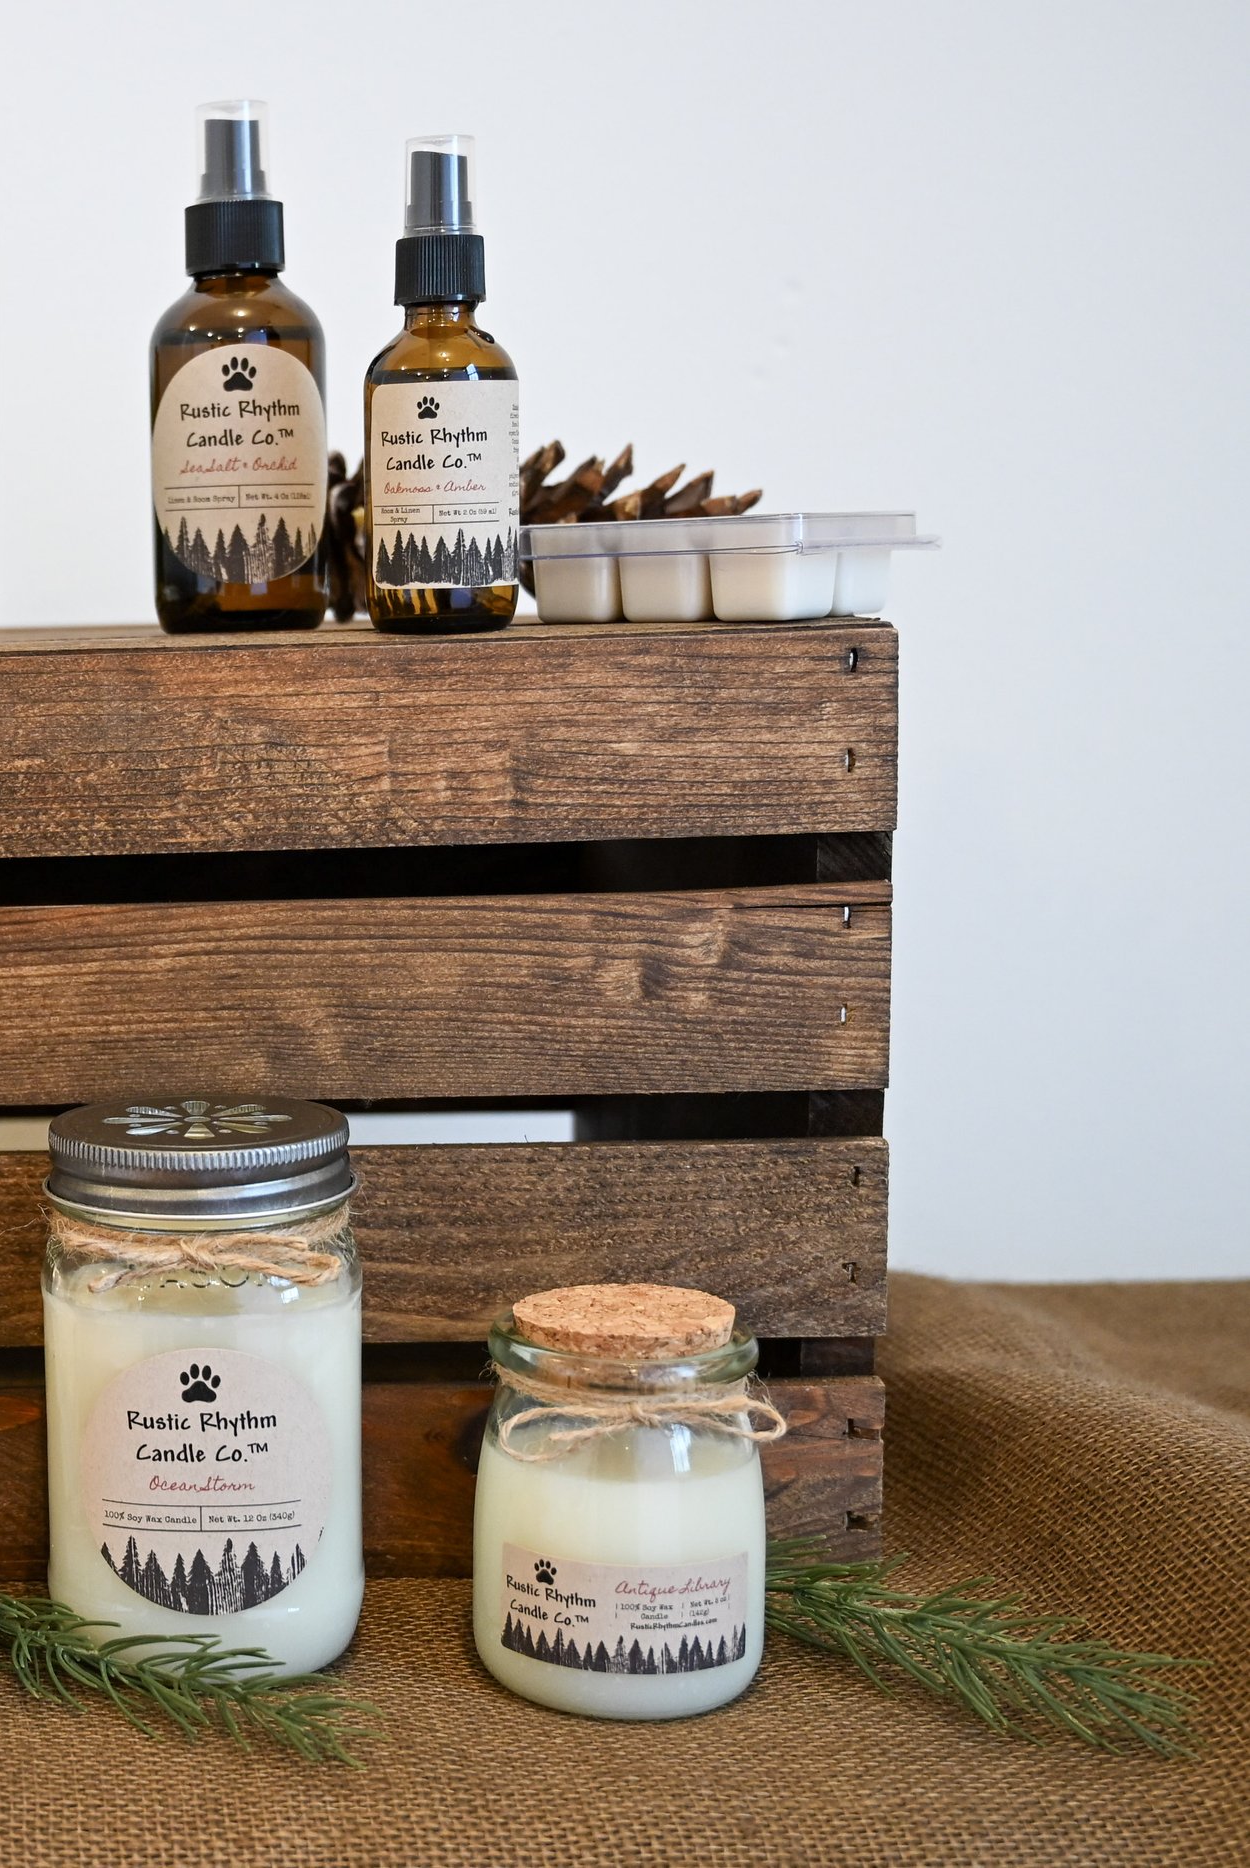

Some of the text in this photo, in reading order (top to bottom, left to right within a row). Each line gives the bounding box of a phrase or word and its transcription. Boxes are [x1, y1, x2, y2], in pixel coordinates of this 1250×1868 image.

[181, 399, 299, 422] Rustic Rhythm
[187, 429, 244, 447] Candle
[381, 427, 487, 448] Rustic Rhythm
[252, 457, 297, 471] Orchid
[387, 454, 435, 470] Candle
[384, 482, 433, 494] Oakmoss
[444, 479, 486, 491] Amber
[127, 1410, 277, 1436] Rustic Rhythm
[136, 1443, 205, 1462] Candle
[104, 1510, 197, 1524] 100% Soy Wax Candle
[209, 1511, 295, 1523] Net Wt. 12 Oz (340g)
[506, 1575, 595, 1609] Rustic Rhythm
[615, 1577, 731, 1603] Antique Library
[510, 1599, 548, 1620] Candle
[642, 1604, 656, 1612] Soy
